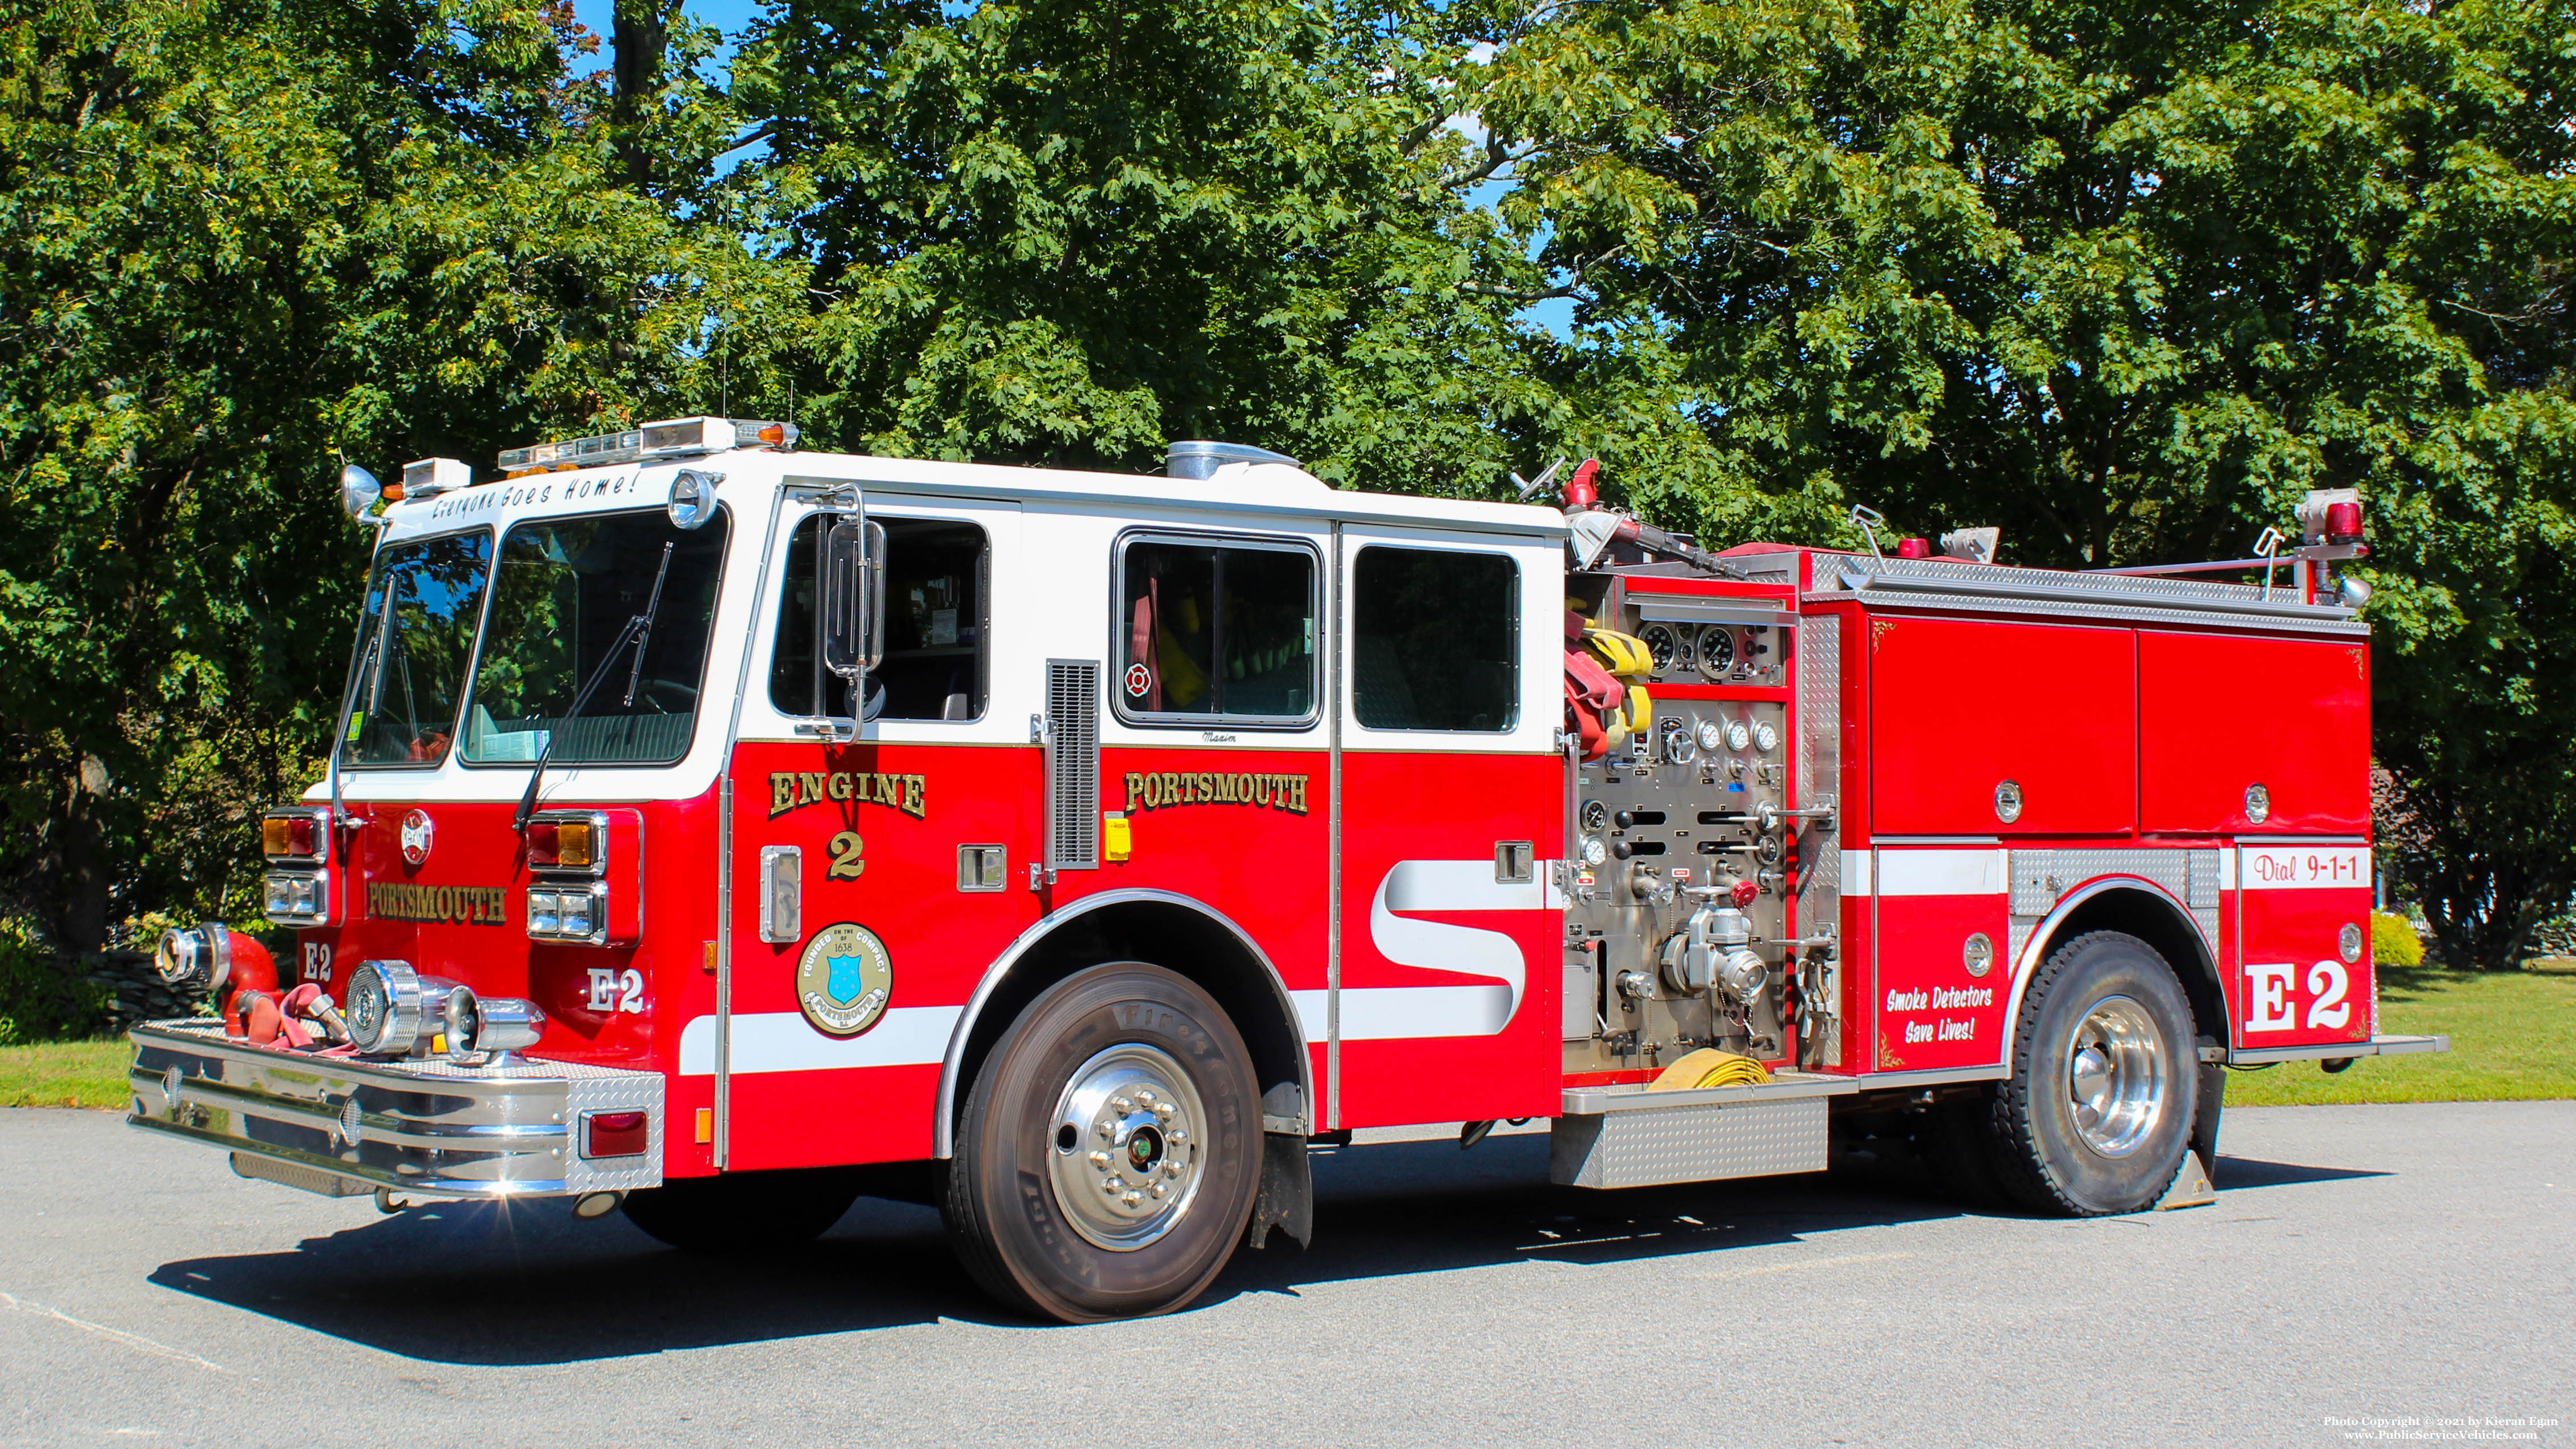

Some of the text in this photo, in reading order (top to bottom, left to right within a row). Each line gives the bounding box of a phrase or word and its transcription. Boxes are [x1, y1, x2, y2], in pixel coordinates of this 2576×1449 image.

[433, 471, 640, 520] Everyone Goes Home!
[1203, 730, 1236, 742] Maxim
[769, 772, 925, 818] ENGINE
[1125, 772, 1308, 815] PORTSMOUTH
[829, 831, 865, 879] 2
[2254, 855, 2356, 881] Dial 9-1-1
[368, 882, 507, 924] PORTSMOUTH
[804, 934, 831, 977] FOUNDED
[835, 943, 852, 952] 1638
[856, 932, 885, 973] COMPACT
[1886, 985, 1992, 1012] Smoke Detectors
[1905, 1017, 1975, 1044] Save Lives!
